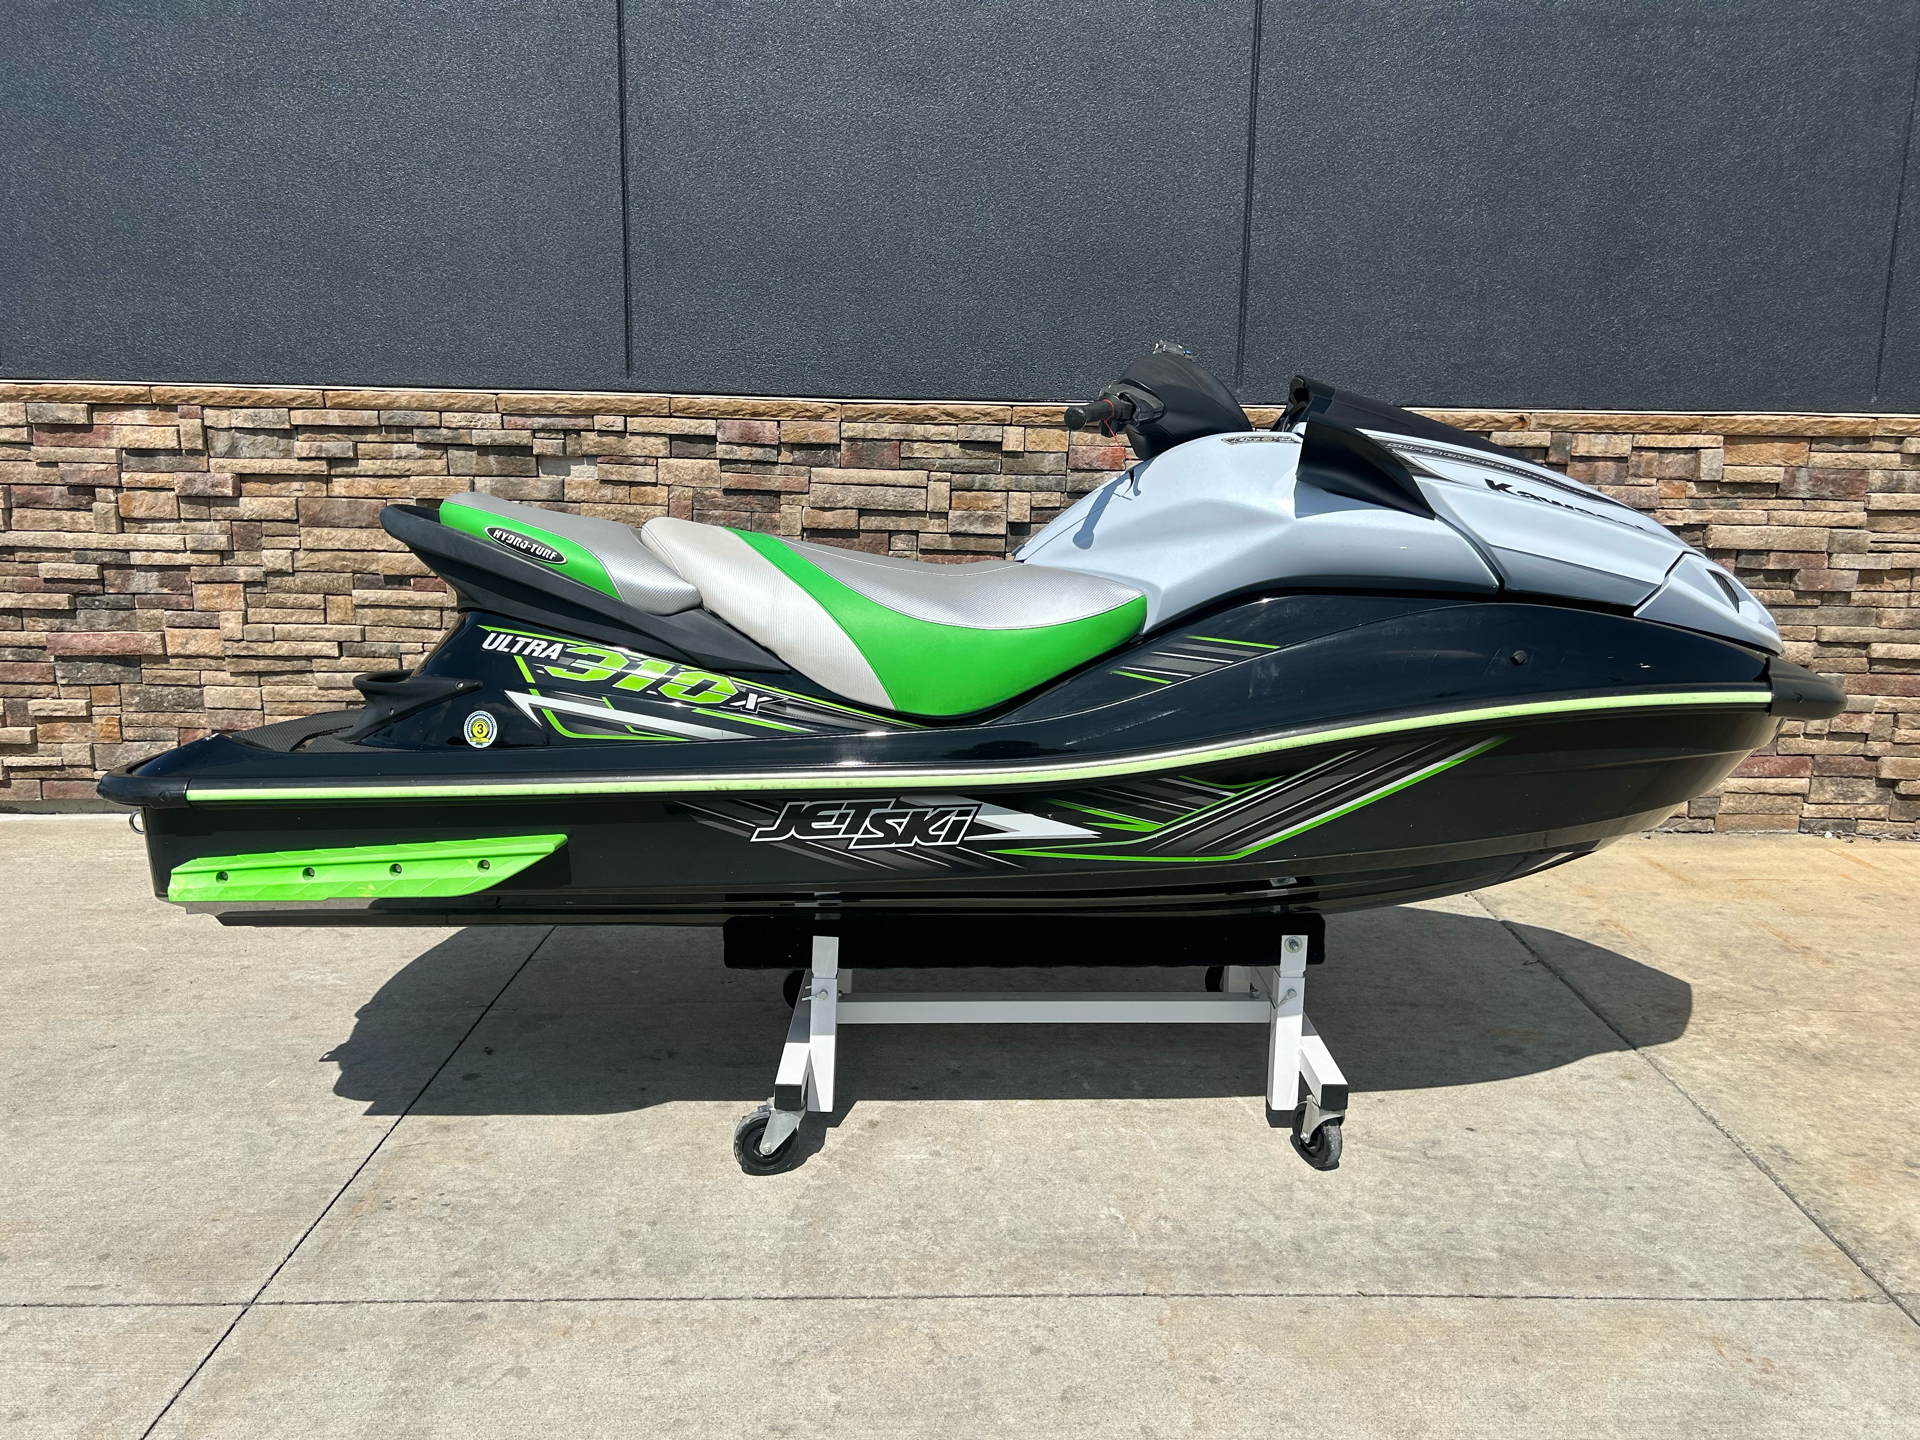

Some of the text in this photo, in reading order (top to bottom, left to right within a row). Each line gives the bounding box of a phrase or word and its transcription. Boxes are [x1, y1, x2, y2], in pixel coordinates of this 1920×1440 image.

[1484, 478, 1647, 531] Kawa
[492, 529, 558, 561] HYDRO-TURF
[481, 632, 565, 661] ULTRA
[476, 723, 484, 735] 3
